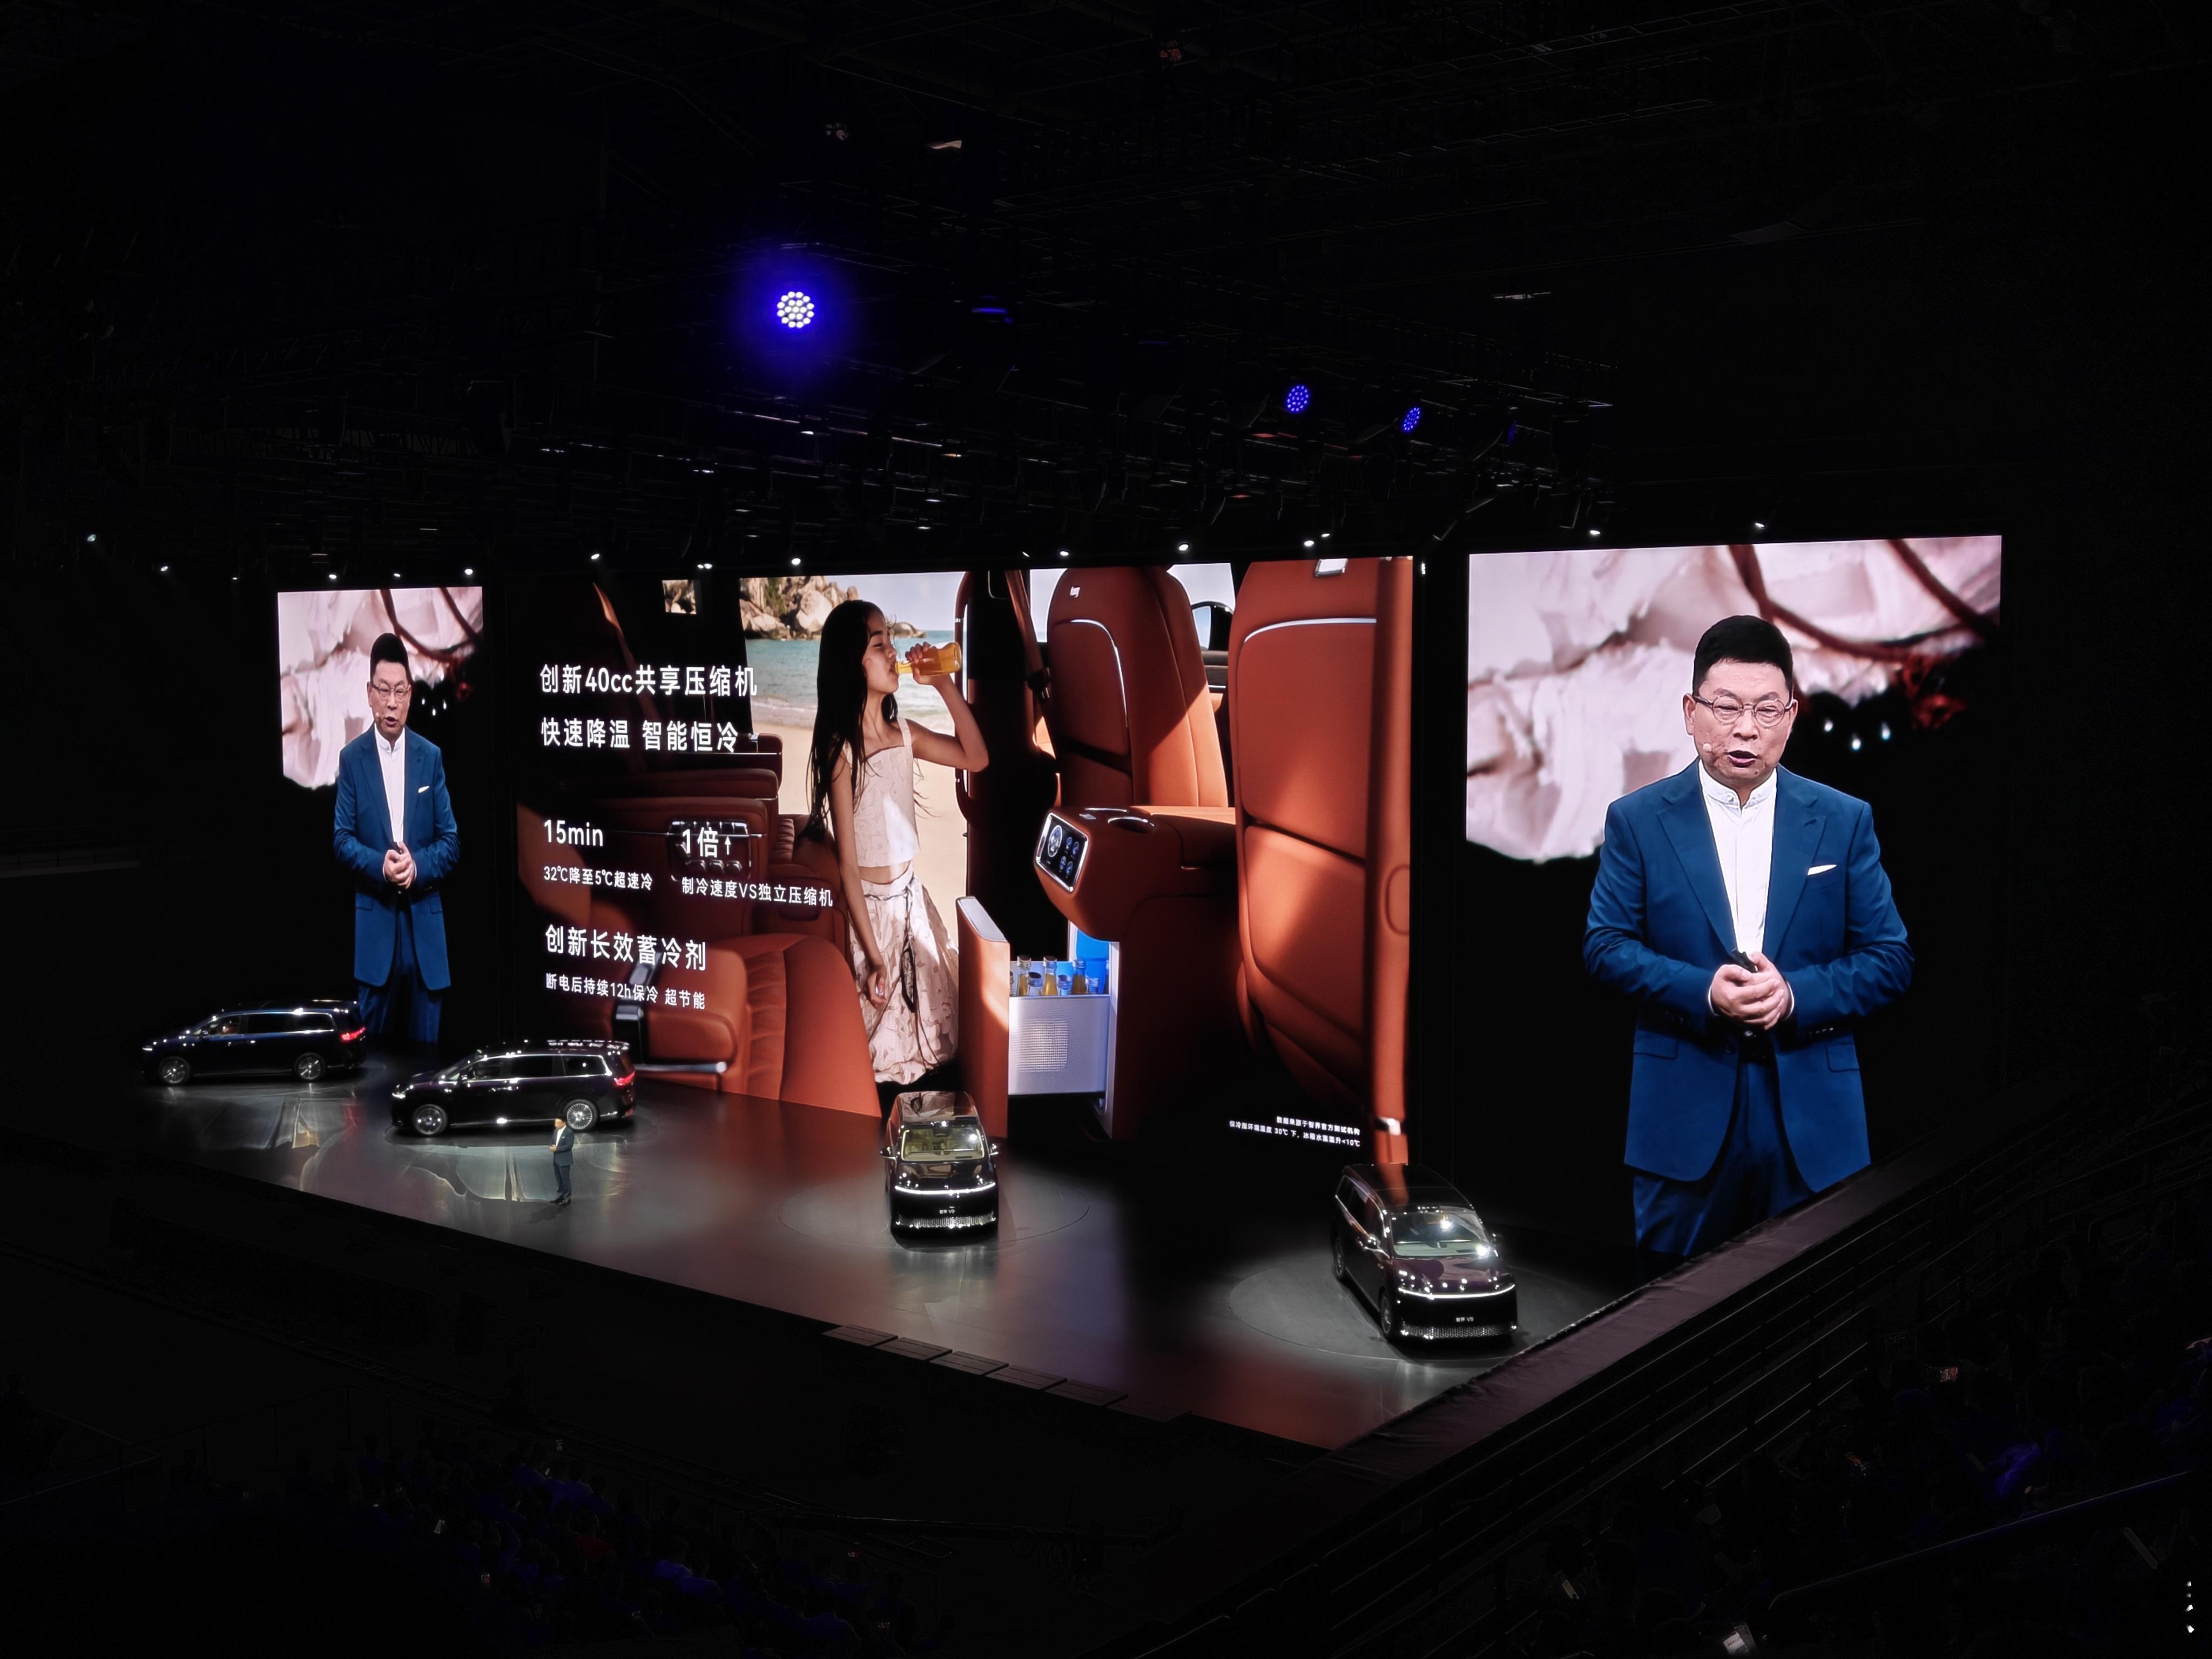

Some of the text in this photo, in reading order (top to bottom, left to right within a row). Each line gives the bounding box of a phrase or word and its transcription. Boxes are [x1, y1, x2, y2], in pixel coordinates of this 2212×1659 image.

[540, 664, 757, 697] 创新40cc共享压缩机
[541, 718, 738, 752] 快速降温 智能恒冷
[544, 819, 604, 847] 15min
[682, 876, 833, 907] 制冷速度VS独立压缩机
[545, 924, 706, 971] 创新长效蓄冷剂
[546, 973, 706, 1009] 断电后持续12h保冷 超节能
